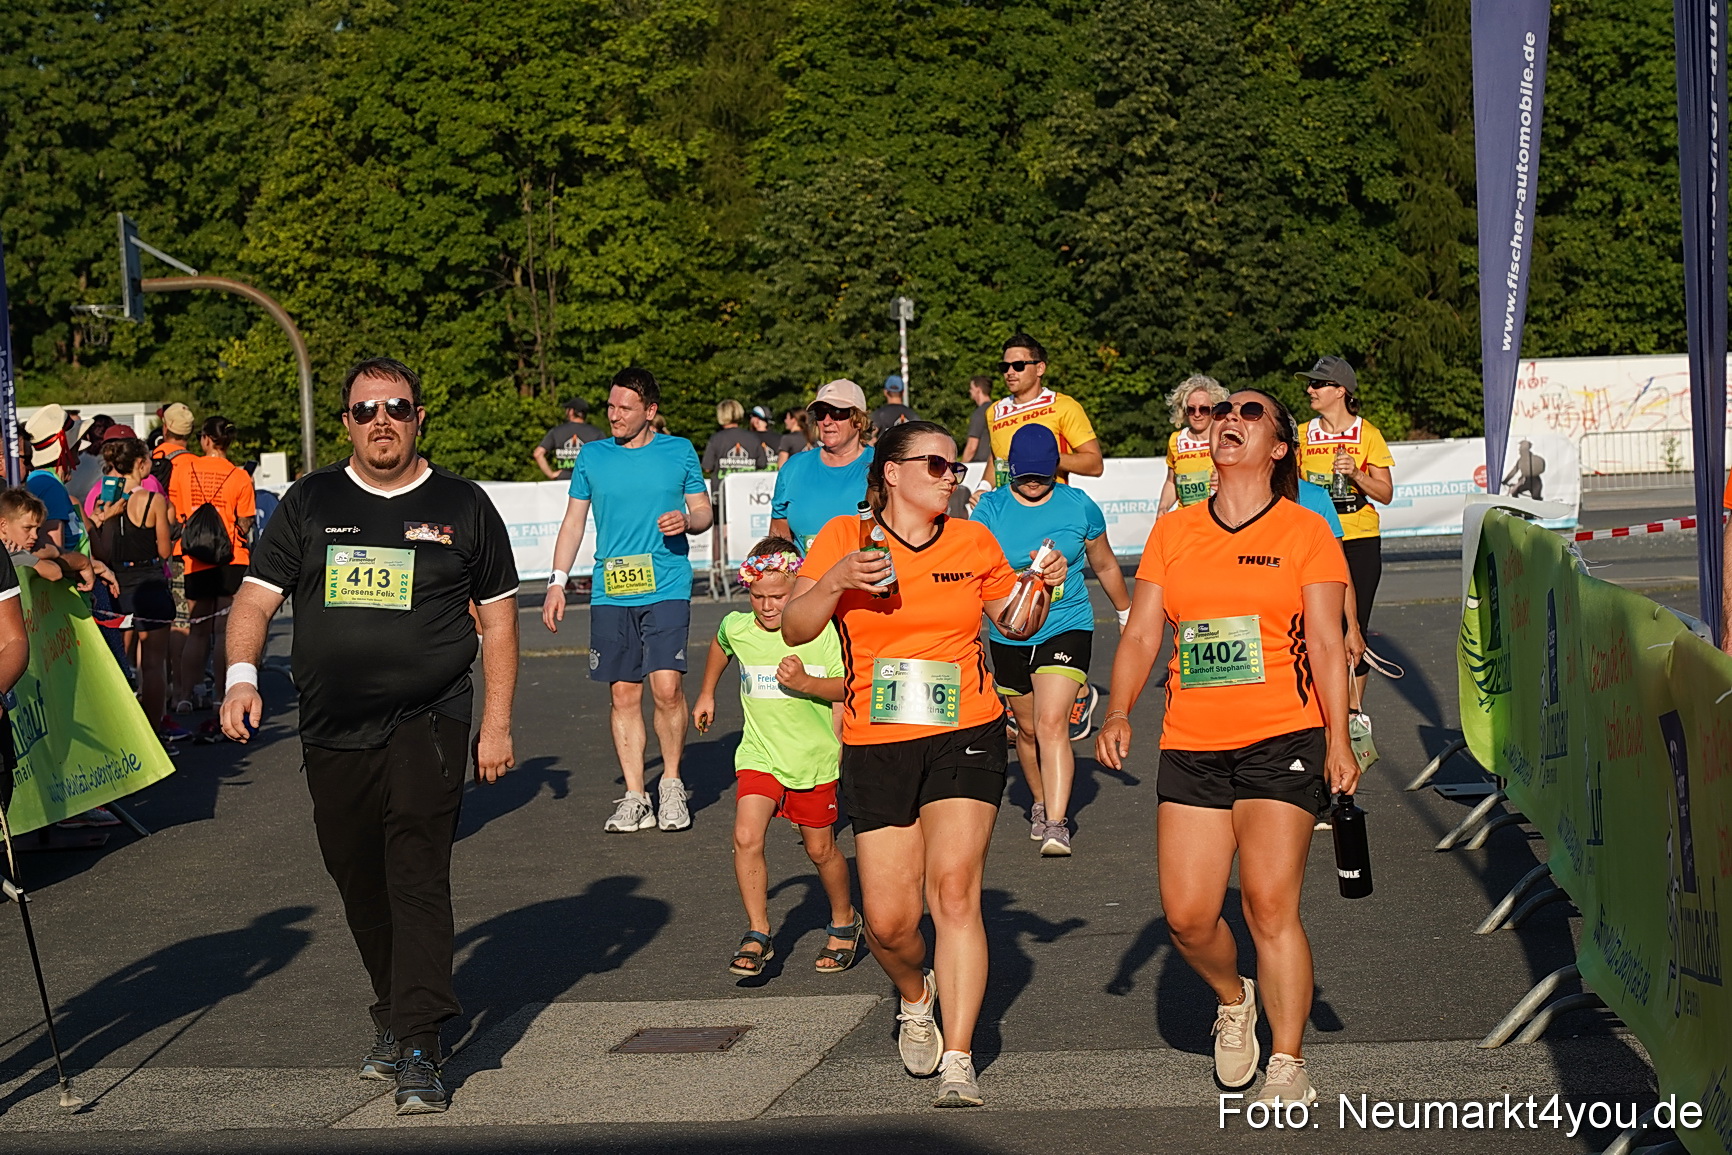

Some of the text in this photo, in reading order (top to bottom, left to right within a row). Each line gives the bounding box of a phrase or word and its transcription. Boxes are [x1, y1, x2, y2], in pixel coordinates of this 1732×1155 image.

[1502, 31, 1536, 351] www.fischer-automobile.de
[992, 407, 1056, 432] MAX BÖGL
[1306, 446, 1360, 456] MAX BGL
[1179, 482, 1206, 495] 1590
[1397, 482, 1476, 498] FAHRRÄDER
[1238, 555, 1281, 567] THULE
[330, 568, 338, 599] WALK
[346, 566, 391, 588] 413
[400, 573, 408, 600] 2022
[610, 567, 644, 584] 1351
[341, 588, 395, 598] Gresens Felix
[1053, 651, 1073, 664] sky
[1183, 651, 1191, 675] RUN
[1190, 640, 1248, 666] 1402
[1249, 642, 1260, 674] 2022
[757, 673, 777, 683] Freie
[1189, 663, 1251, 675] Garthoff Stephanie
[875, 687, 885, 710] RUN
[947, 688, 957, 718] 2022
